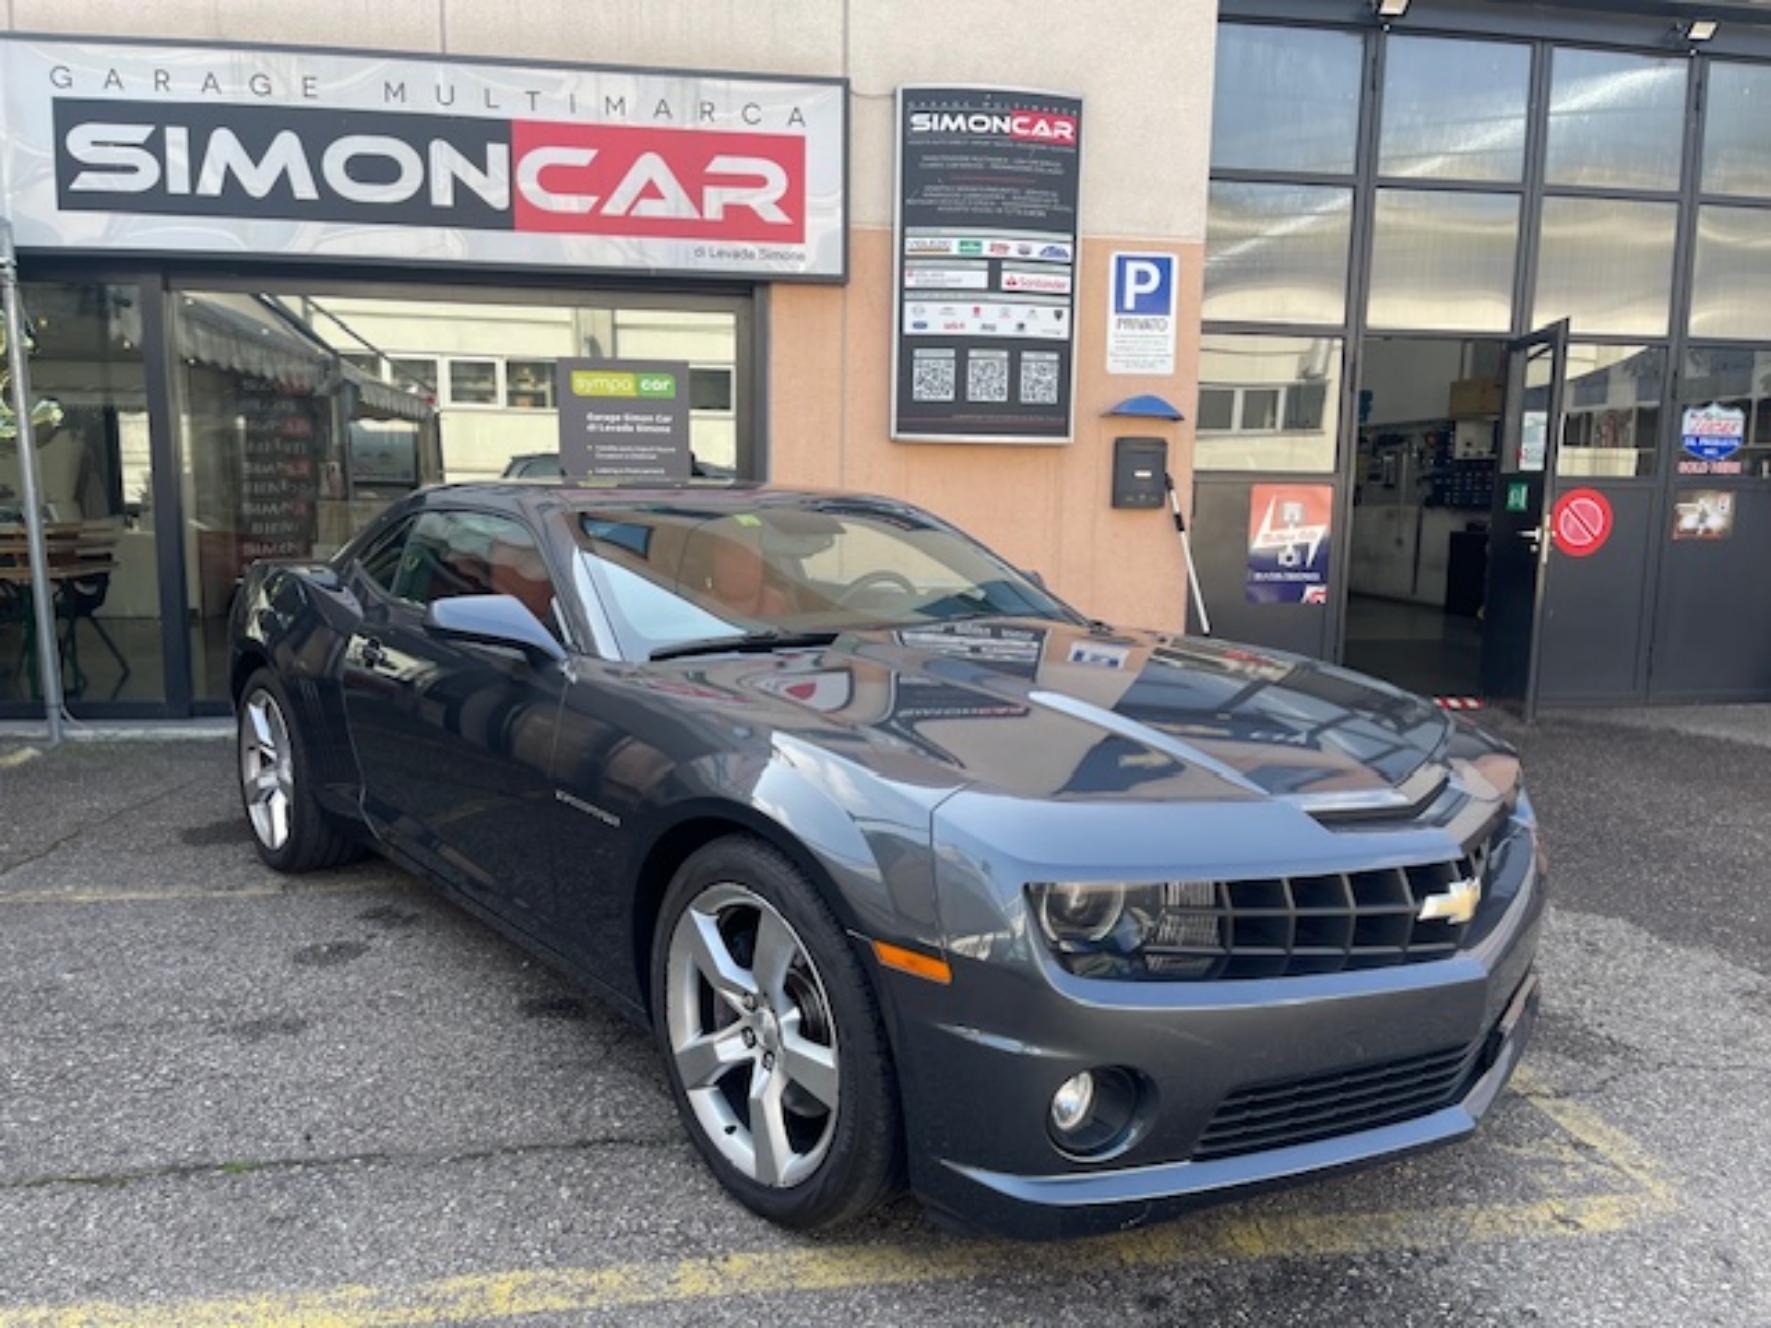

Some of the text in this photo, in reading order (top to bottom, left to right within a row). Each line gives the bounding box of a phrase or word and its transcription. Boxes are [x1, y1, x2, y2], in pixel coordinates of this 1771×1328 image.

[50, 65, 806, 127] GARAGE MULTIMARCA
[1123, 260, 1161, 311] P
[640, 379, 671, 391] car
